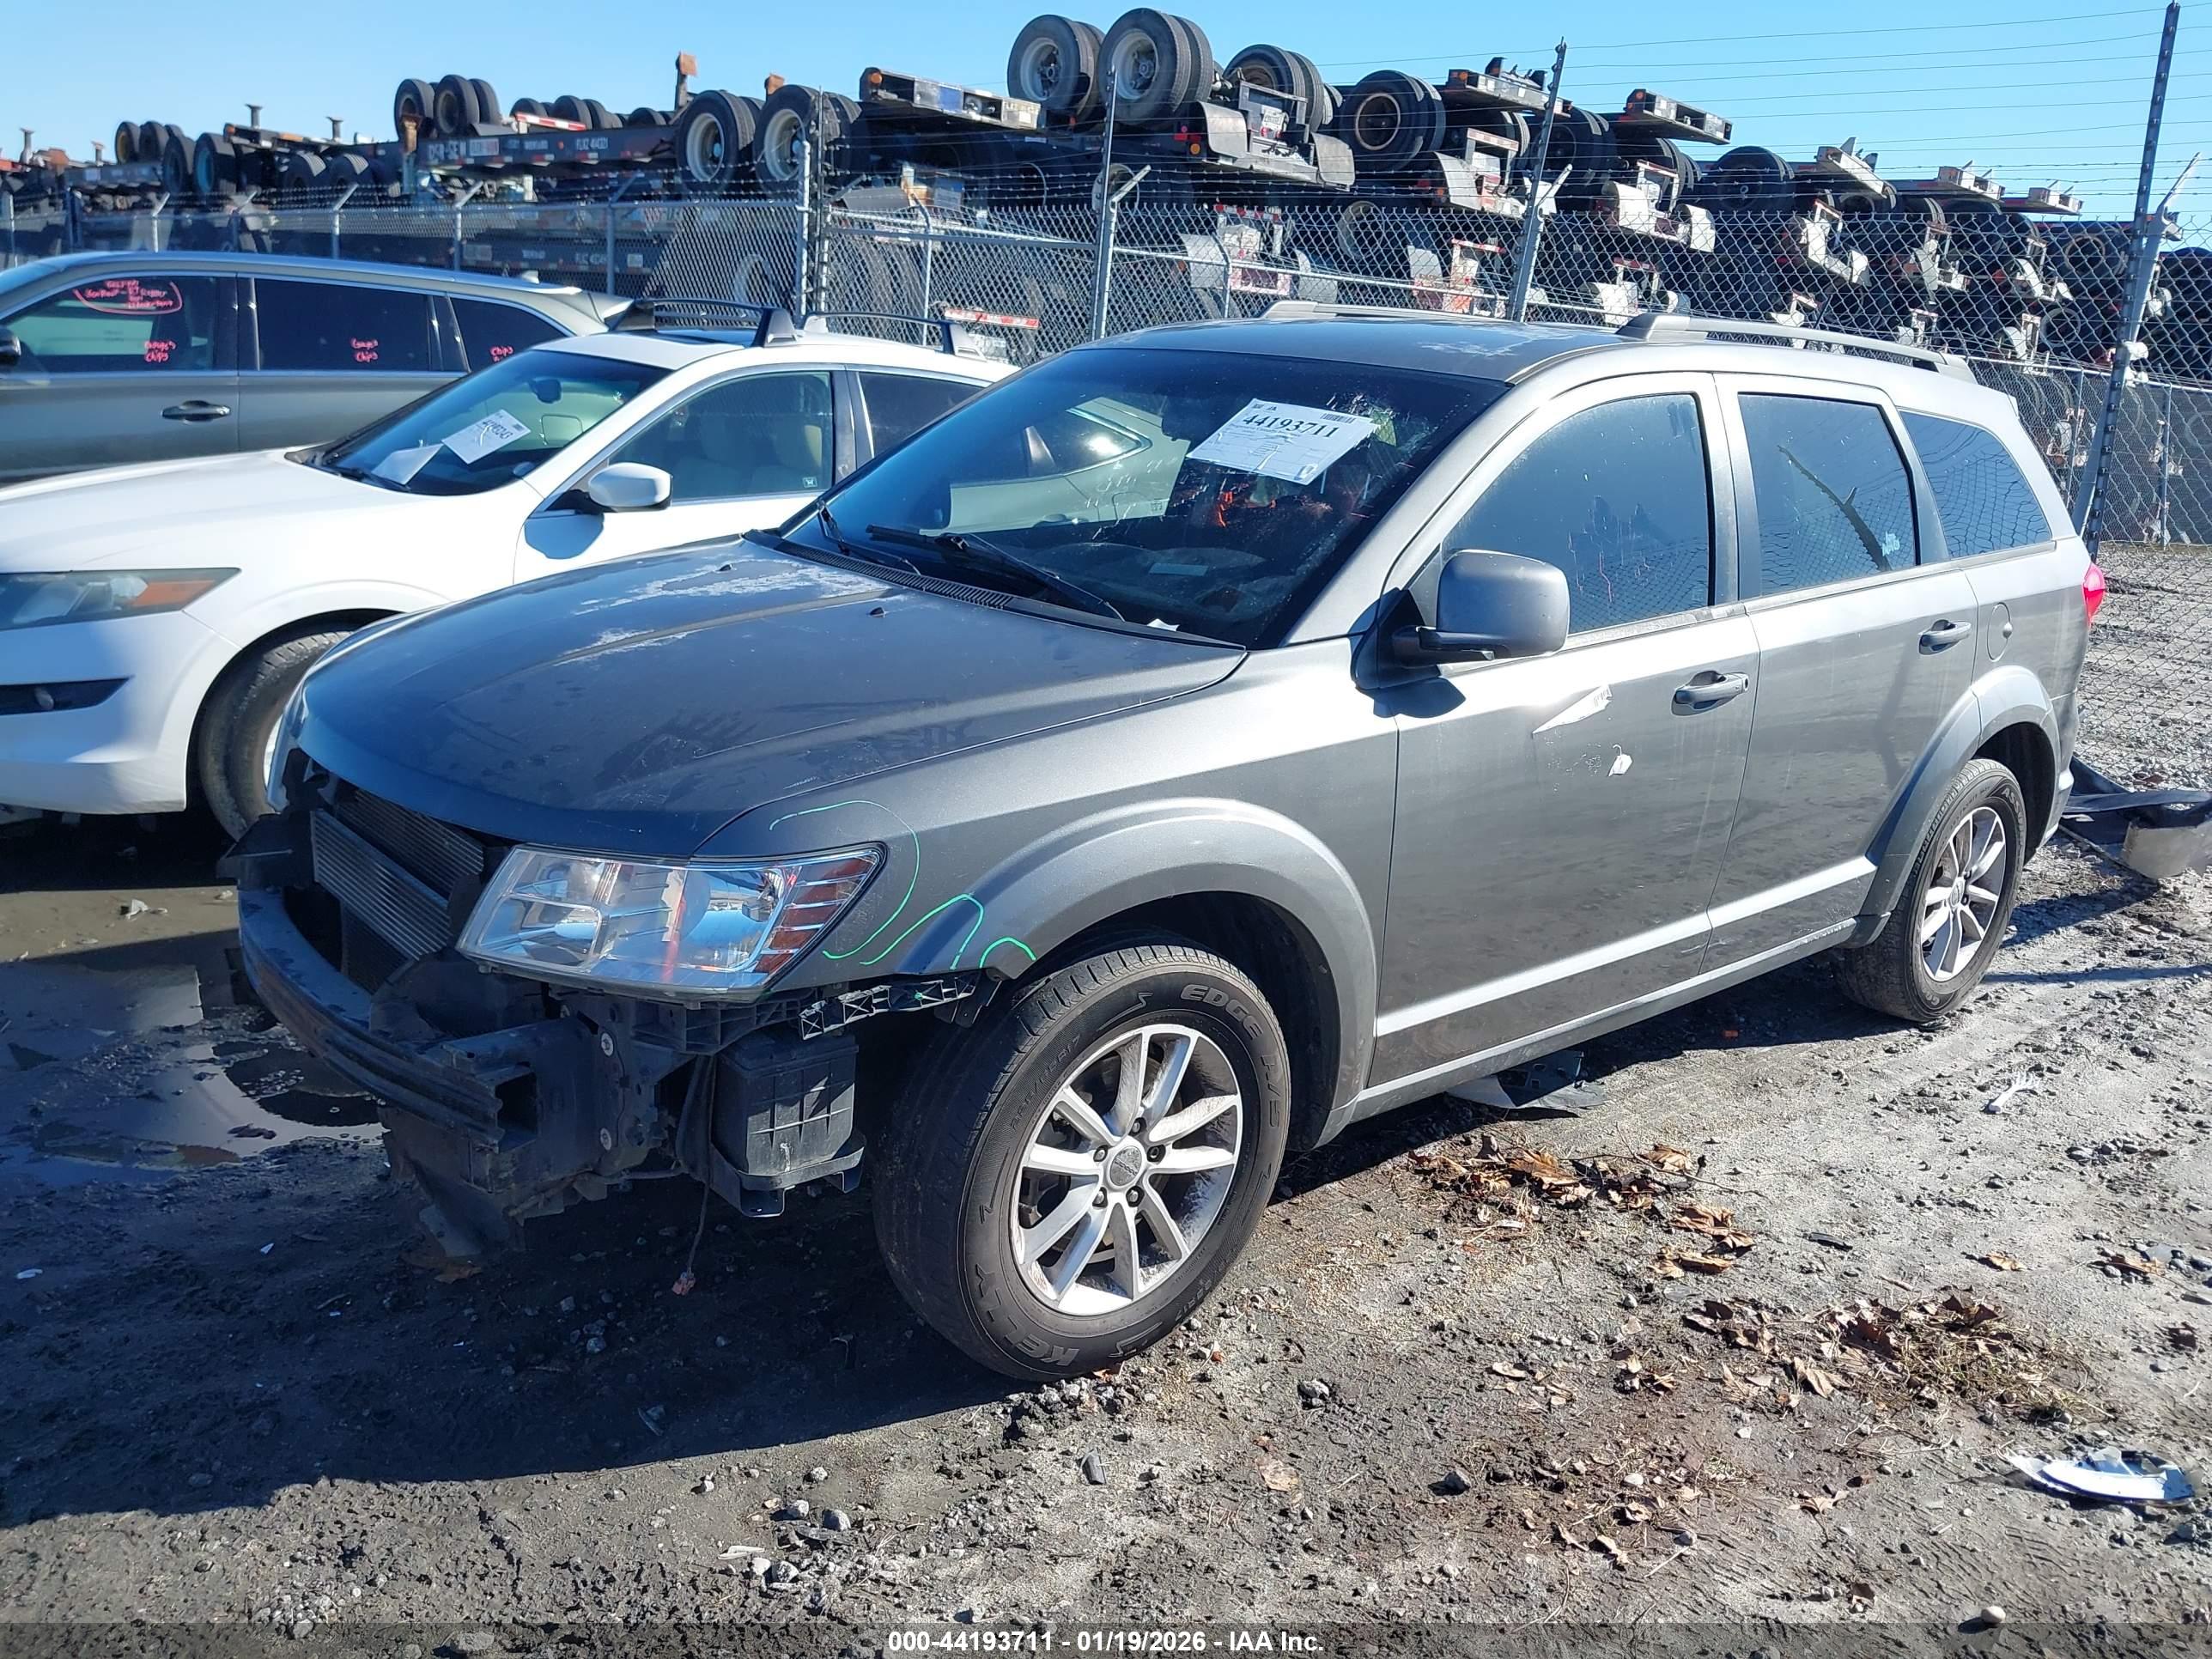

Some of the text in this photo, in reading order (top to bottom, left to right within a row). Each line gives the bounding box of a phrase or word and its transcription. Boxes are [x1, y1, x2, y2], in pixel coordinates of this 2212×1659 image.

[1242, 413, 1340, 438] 44193711
[1181, 984, 1264, 1041] EDGE
[975, 1263, 1080, 1367] KELLY
